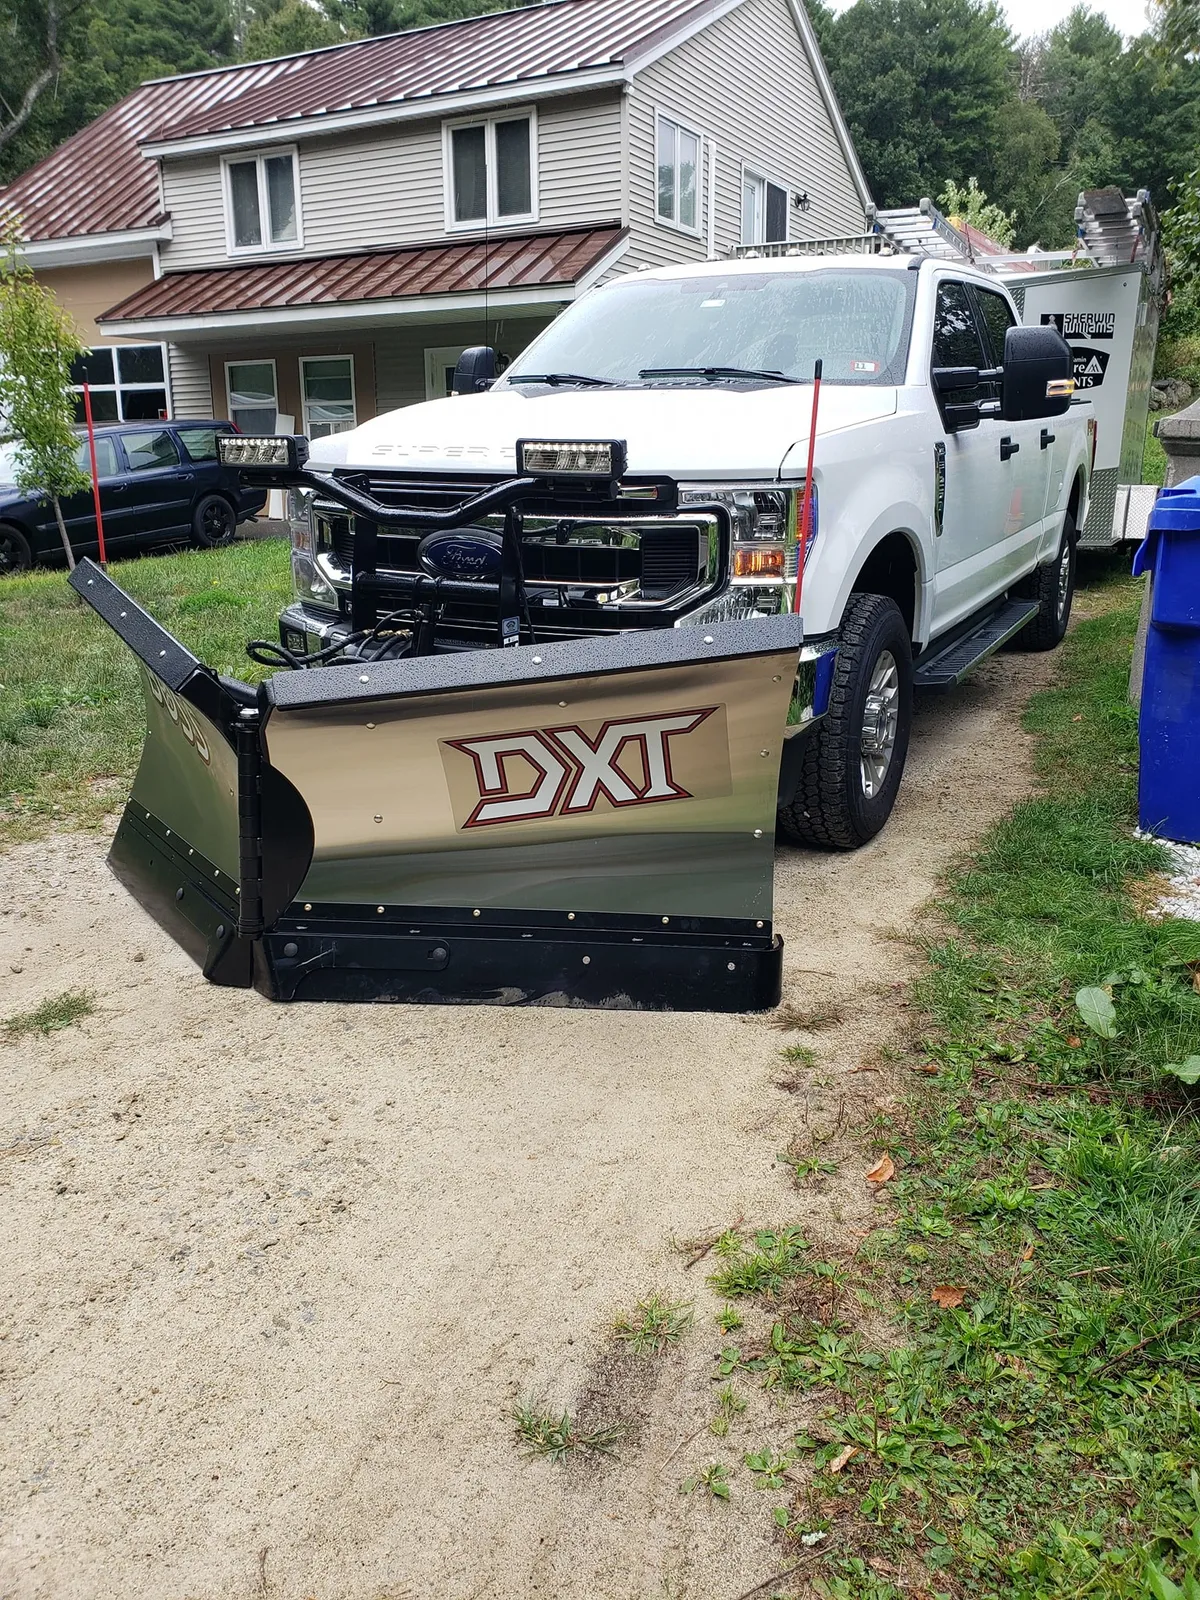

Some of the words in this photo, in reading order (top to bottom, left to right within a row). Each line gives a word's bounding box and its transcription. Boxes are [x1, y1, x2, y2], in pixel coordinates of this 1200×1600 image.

[1064, 313, 1115, 323] SHERWIN
[1072, 376, 1094, 387] NTS
[442, 543, 488, 569] Ford
[442, 706, 720, 829] DXT
